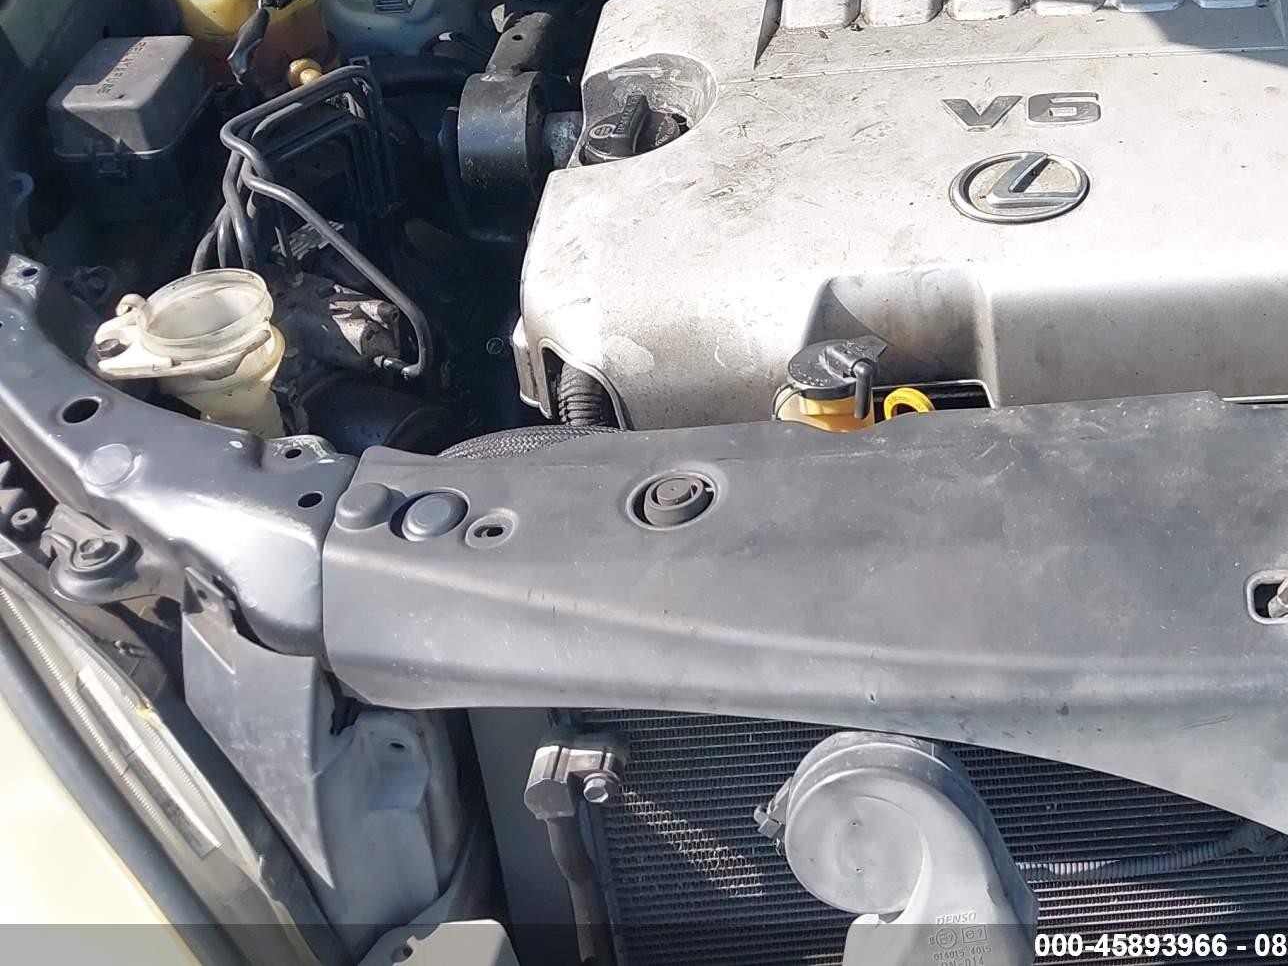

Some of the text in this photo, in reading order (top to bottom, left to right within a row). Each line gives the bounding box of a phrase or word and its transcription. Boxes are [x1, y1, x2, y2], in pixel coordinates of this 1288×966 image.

[939, 91, 1103, 132] V6
[936, 911, 976, 925] DENSO
[934, 944, 992, 961] 014015 4015
